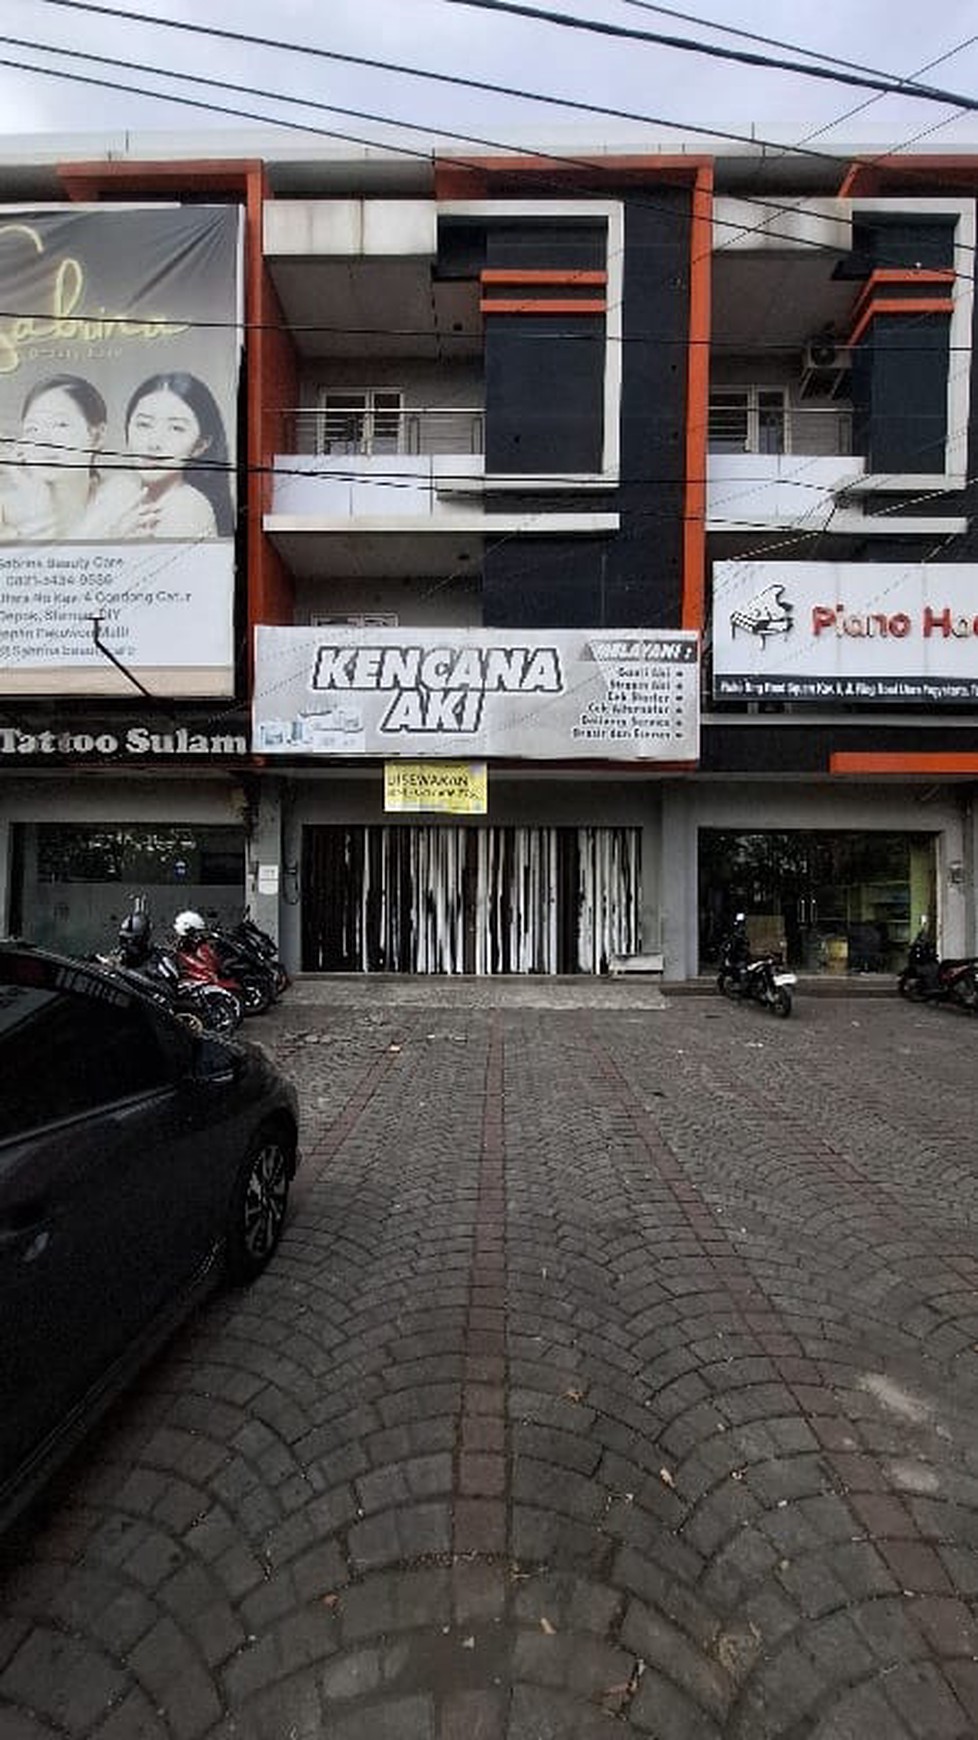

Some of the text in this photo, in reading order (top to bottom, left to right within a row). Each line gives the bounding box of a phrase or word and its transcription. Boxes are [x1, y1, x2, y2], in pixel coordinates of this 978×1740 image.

[812, 604, 911, 639] Piano
[312, 645, 564, 692] KENCANA
[380, 690, 486, 733] AKI
[0, 728, 247, 754] Tattoo Sulam
